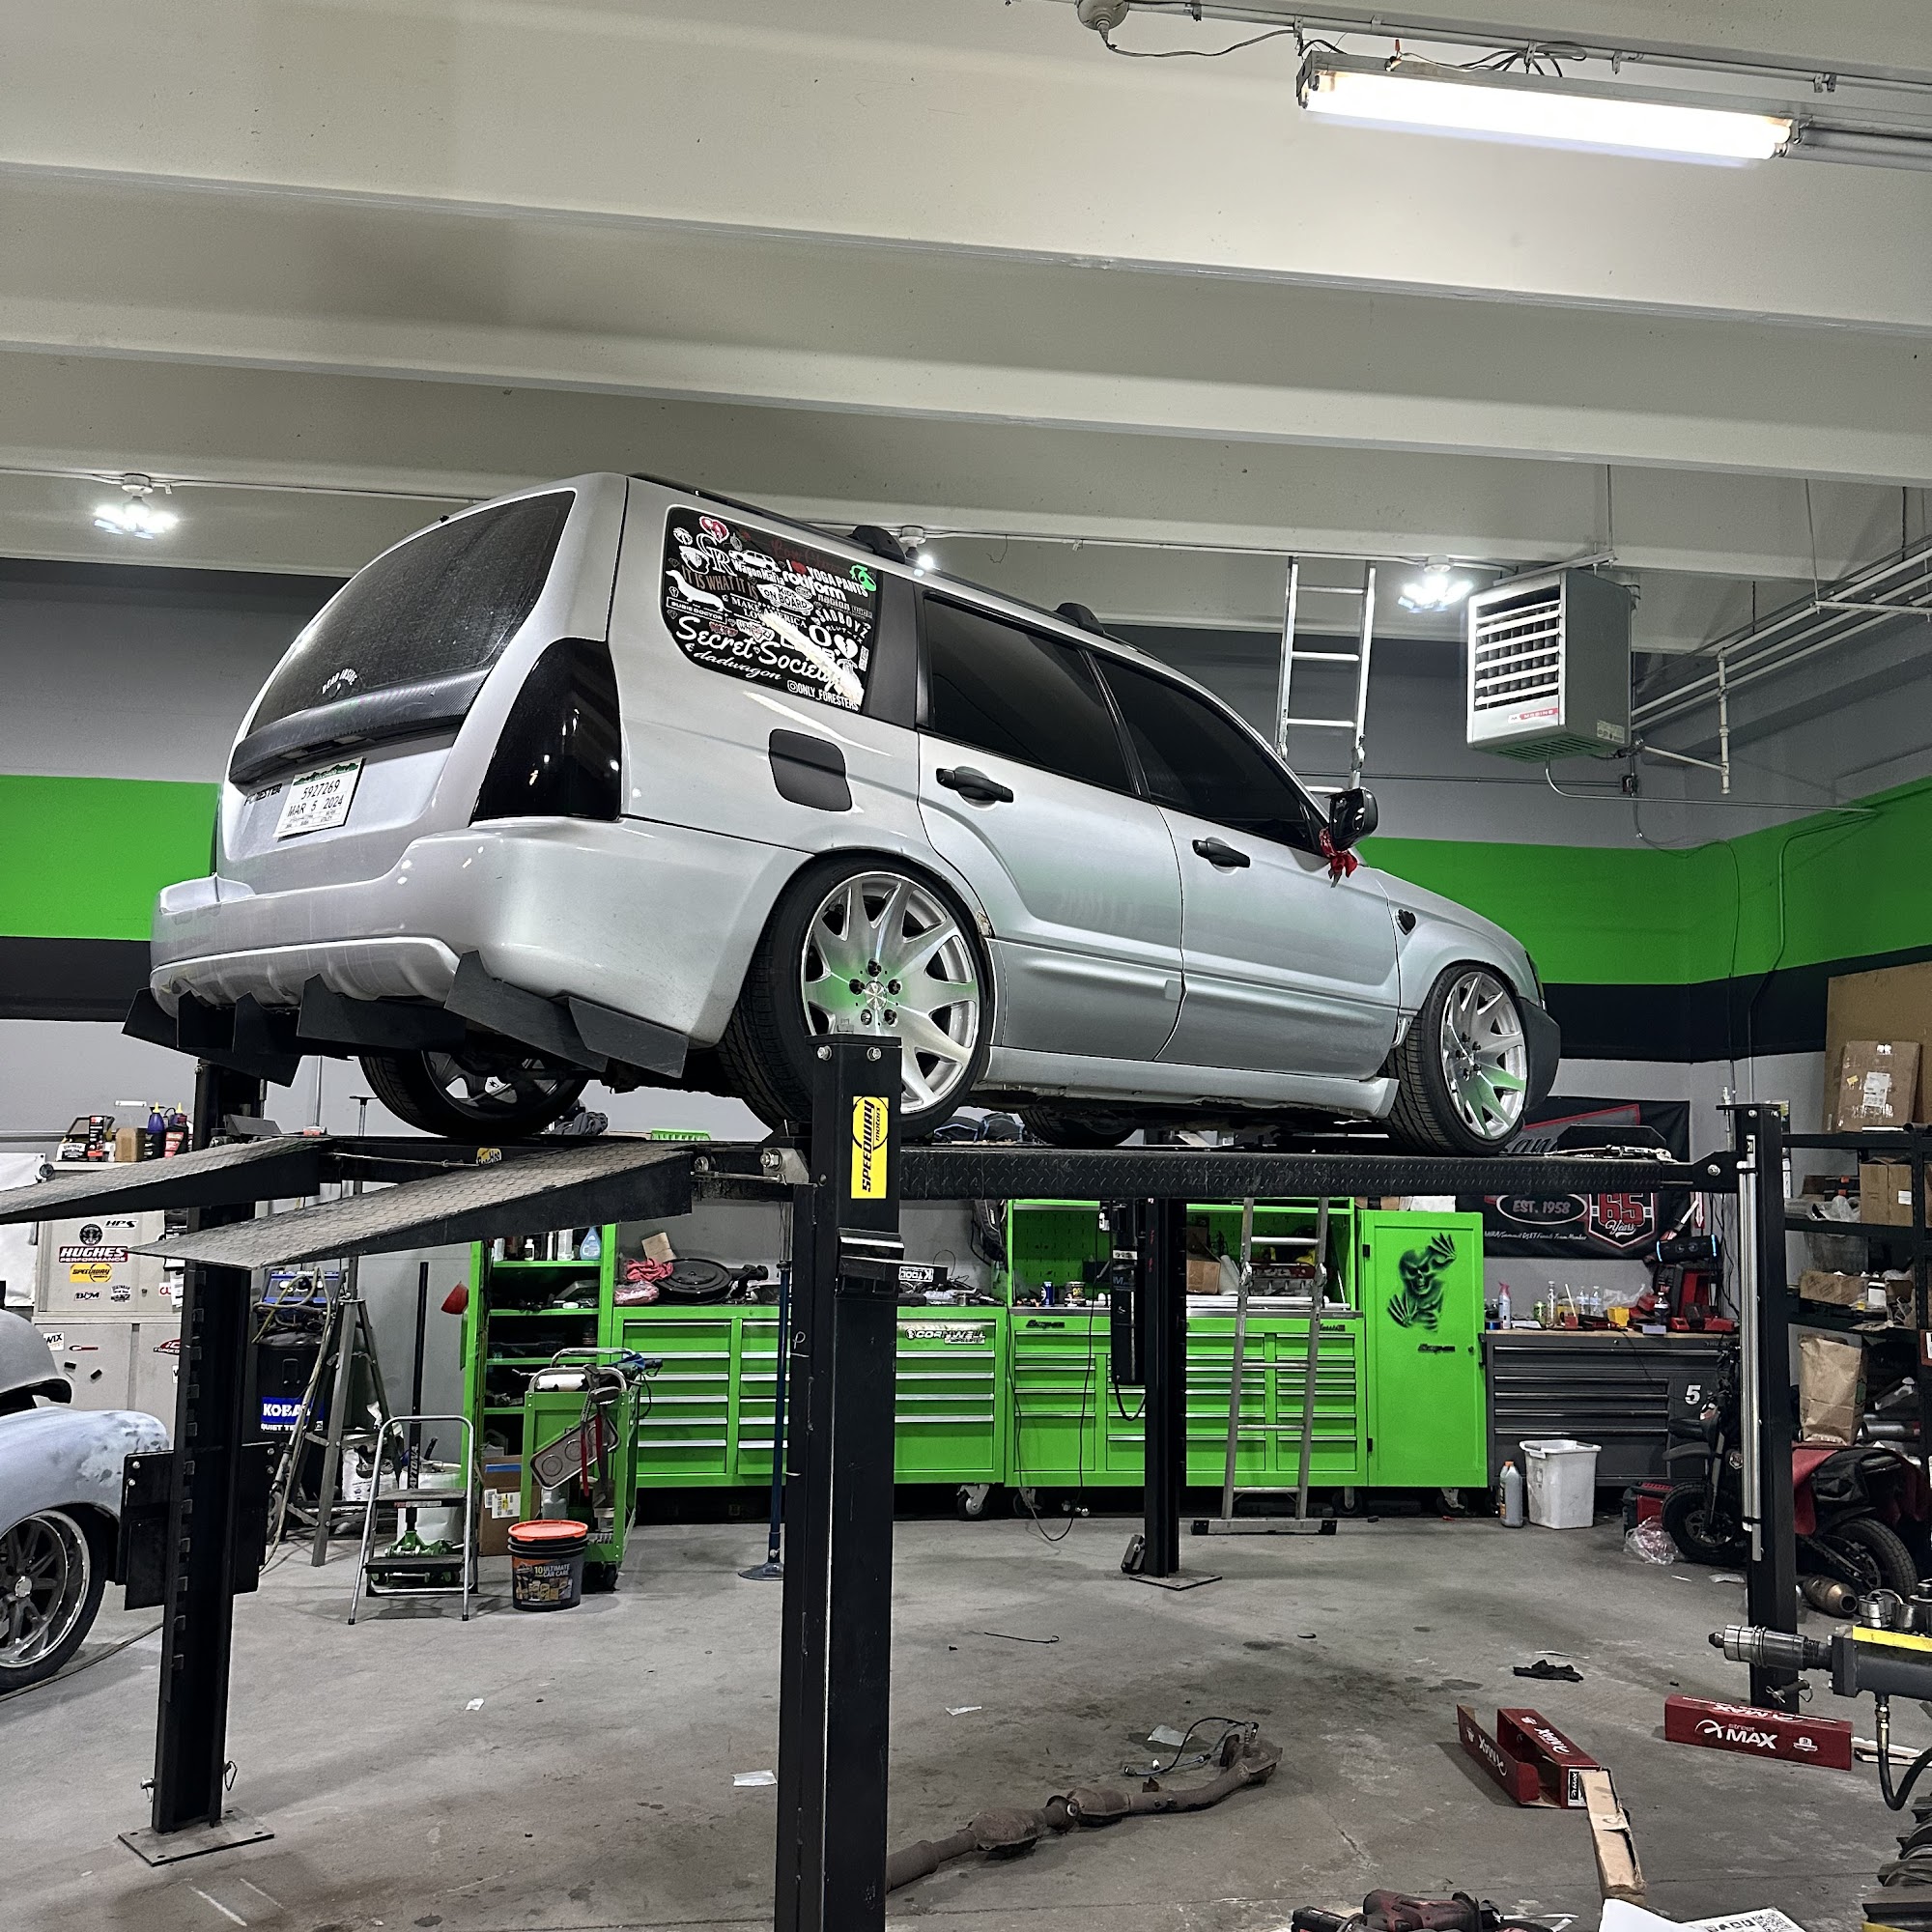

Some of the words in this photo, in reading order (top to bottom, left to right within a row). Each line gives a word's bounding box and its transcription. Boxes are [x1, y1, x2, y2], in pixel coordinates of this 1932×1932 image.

[681, 564, 693, 583] IT
[695, 574, 706, 590] IS
[706, 576, 734, 591] WHAT
[736, 577, 746, 593] IT
[748, 583, 758, 601] IS
[806, 566, 837, 587] YOGA
[835, 576, 868, 597] PANTS
[730, 597, 761, 611] MAKE
[779, 594, 808, 609] BOARD
[694, 606, 723, 620] DOCTOR
[694, 651, 781, 680] dadwagon
[301, 779, 340, 800] 5927269
[288, 803, 307, 817] MAR
[311, 800, 318, 811] 5
[323, 794, 344, 810] 2024
[862, 1099, 874, 1193] SPEEDWAY
[1513, 1201, 1538, 1213] EST.
[1542, 1201, 1571, 1214] 1958
[1605, 1219, 1634, 1237] Years
[60, 1247, 126, 1257] HUGHES
[46, 1334, 63, 1343] WIX
[1685, 1385, 1701, 1405] 5
[410, 1443, 419, 1489] AYTONA
[1728, 1723, 1755, 1732] street
[1726, 1729, 1778, 1749] MAX
